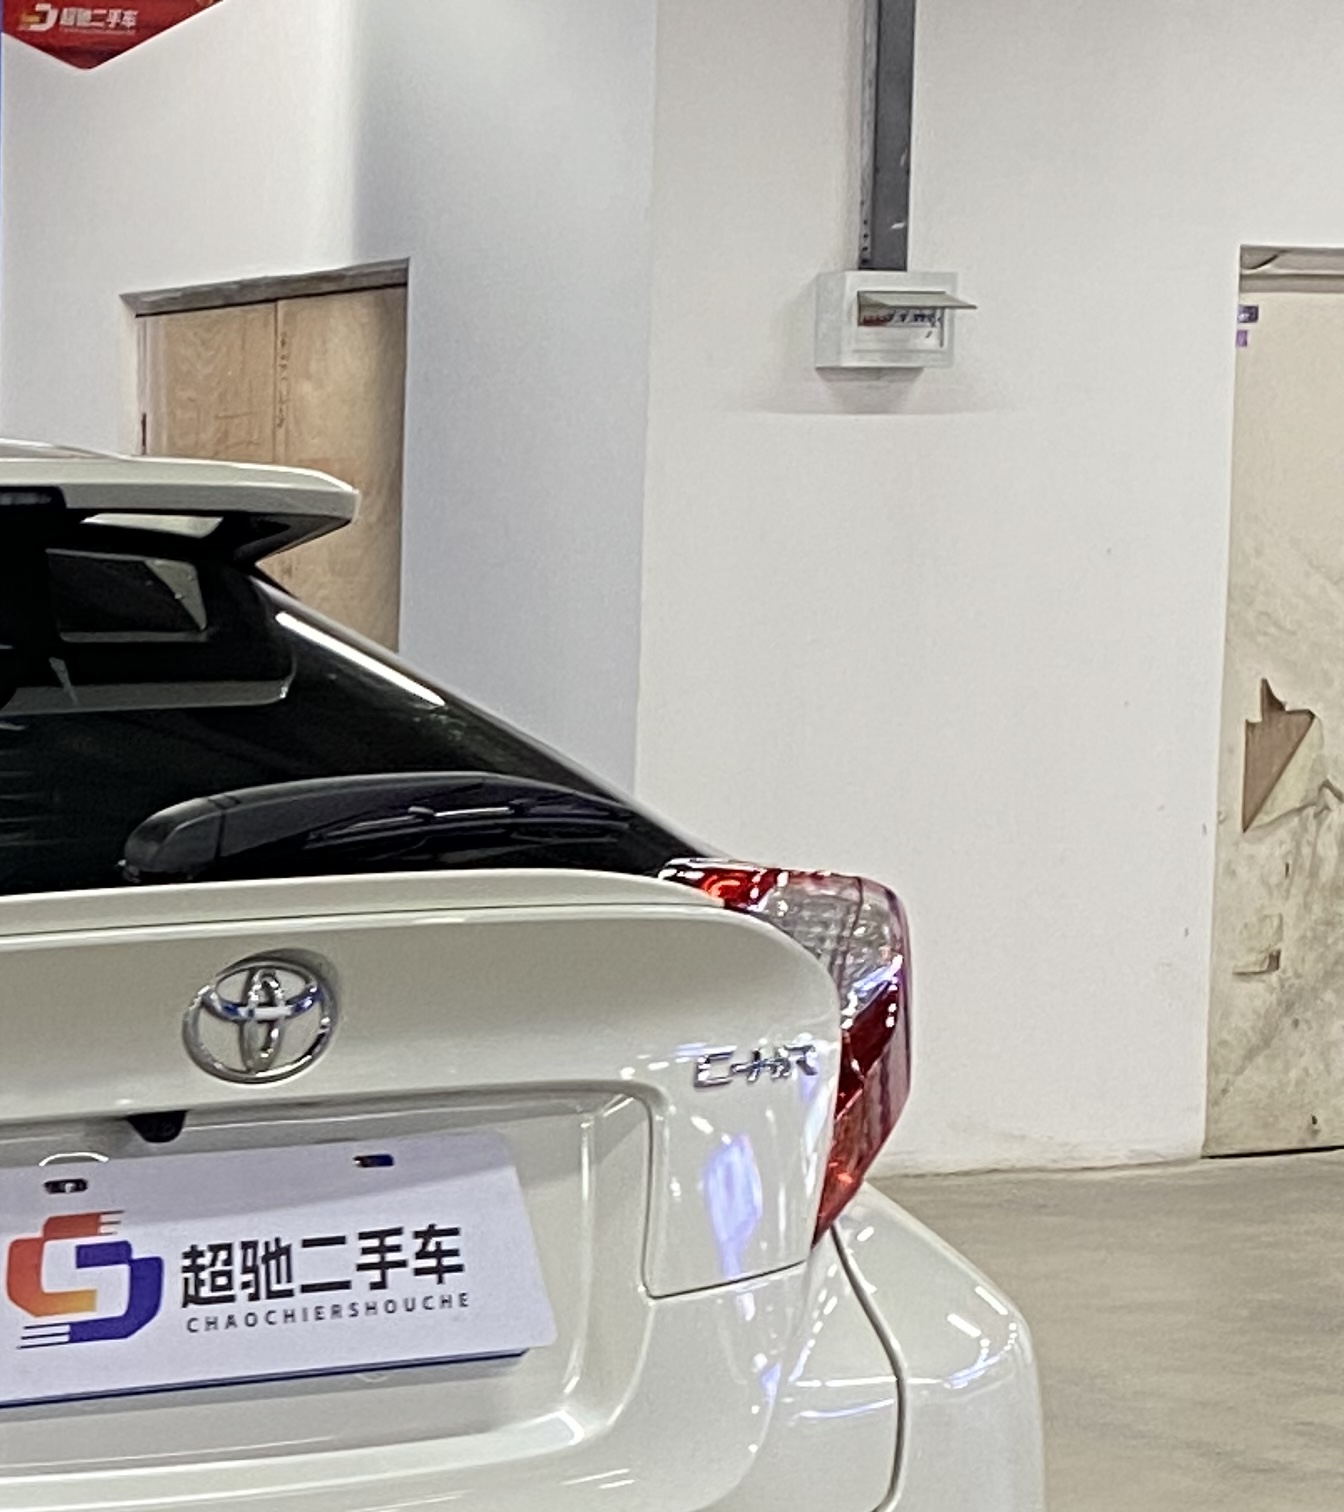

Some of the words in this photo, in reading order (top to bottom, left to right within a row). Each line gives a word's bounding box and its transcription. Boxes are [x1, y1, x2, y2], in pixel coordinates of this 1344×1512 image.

[180, 1223, 465, 1309] 超驰二手车
[186, 1292, 470, 1333] CHAOCHIERSHOUCHE
